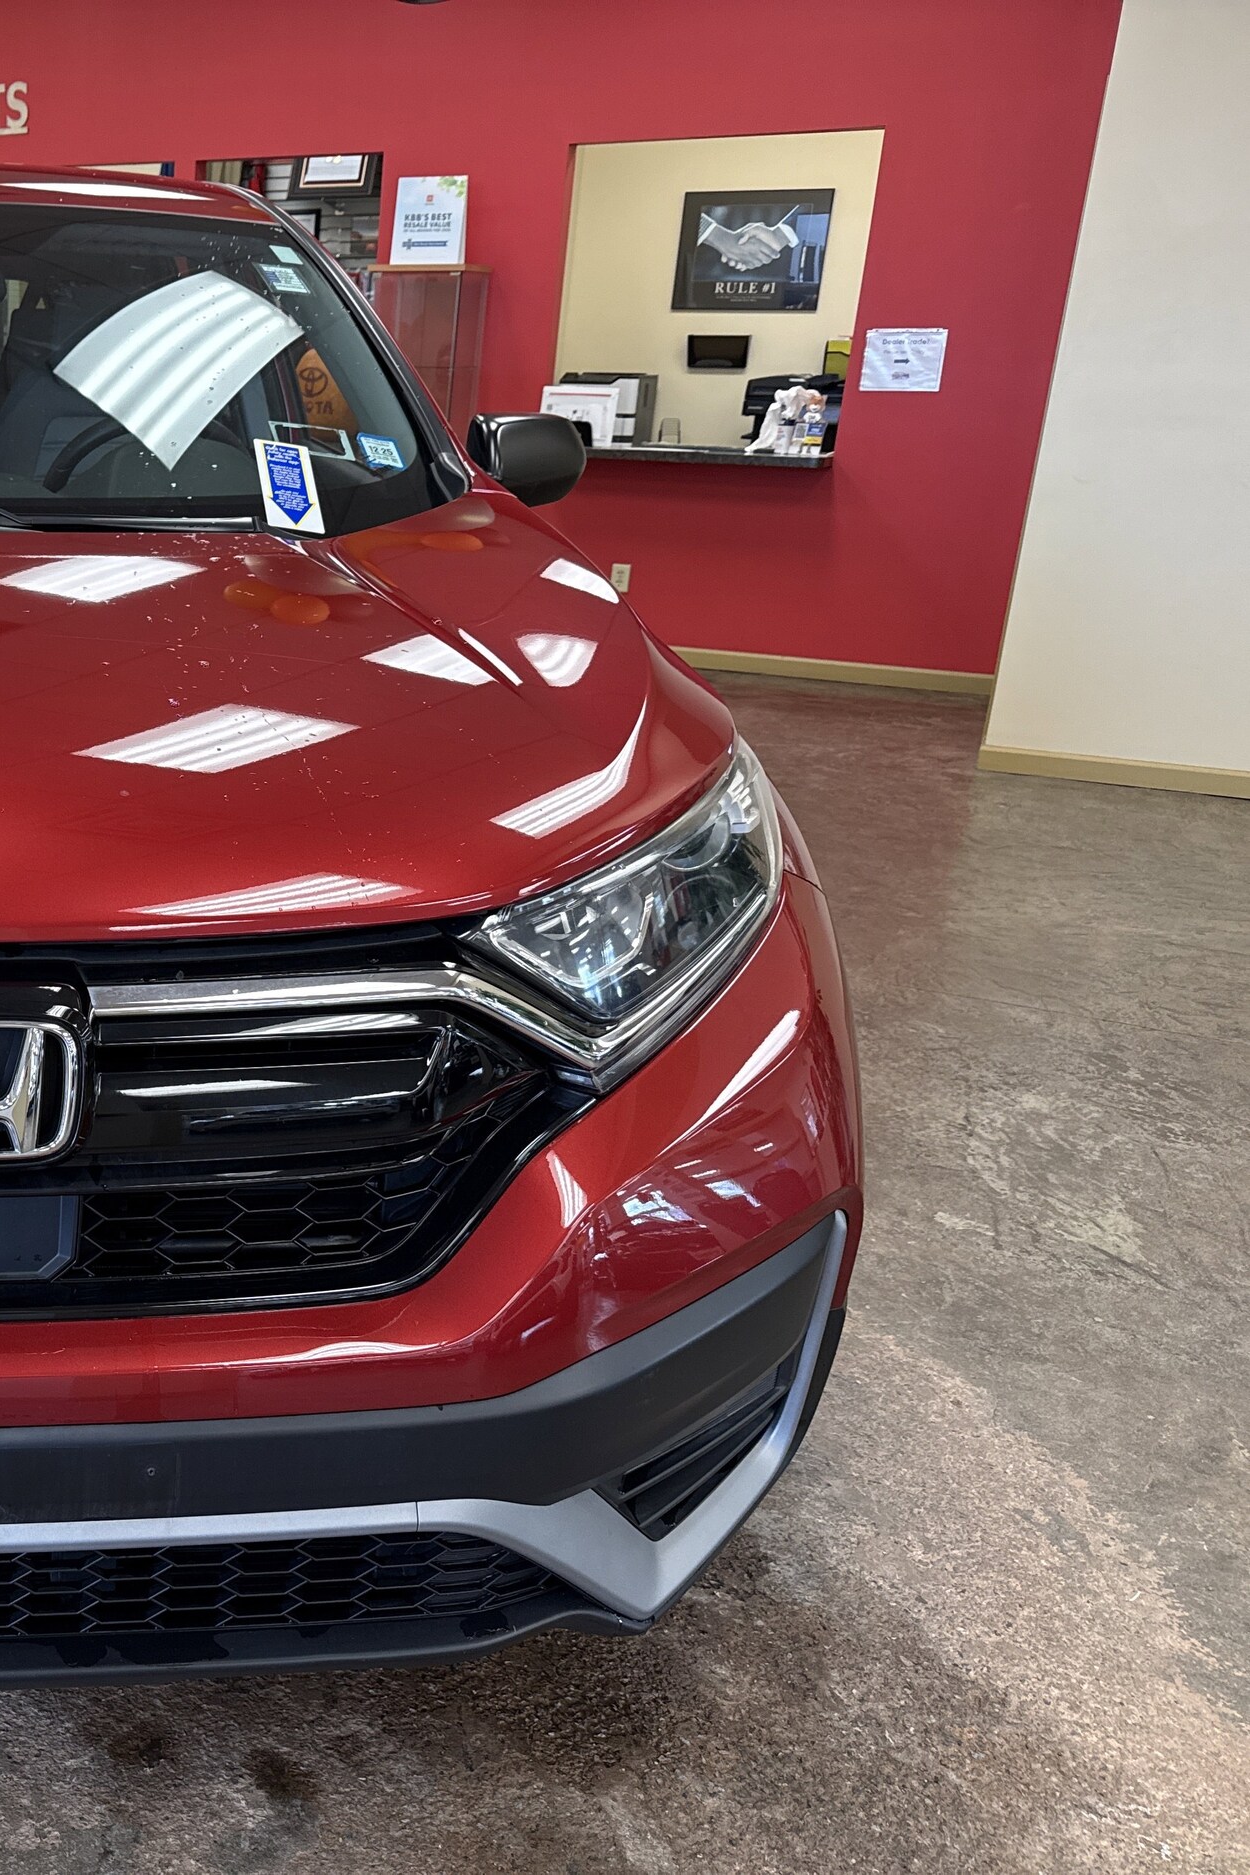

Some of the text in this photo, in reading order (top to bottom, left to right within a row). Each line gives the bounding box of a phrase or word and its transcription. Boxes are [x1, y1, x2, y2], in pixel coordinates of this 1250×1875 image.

[431, 213, 452, 221] BEST
[714, 282, 776, 294] RULE #1
